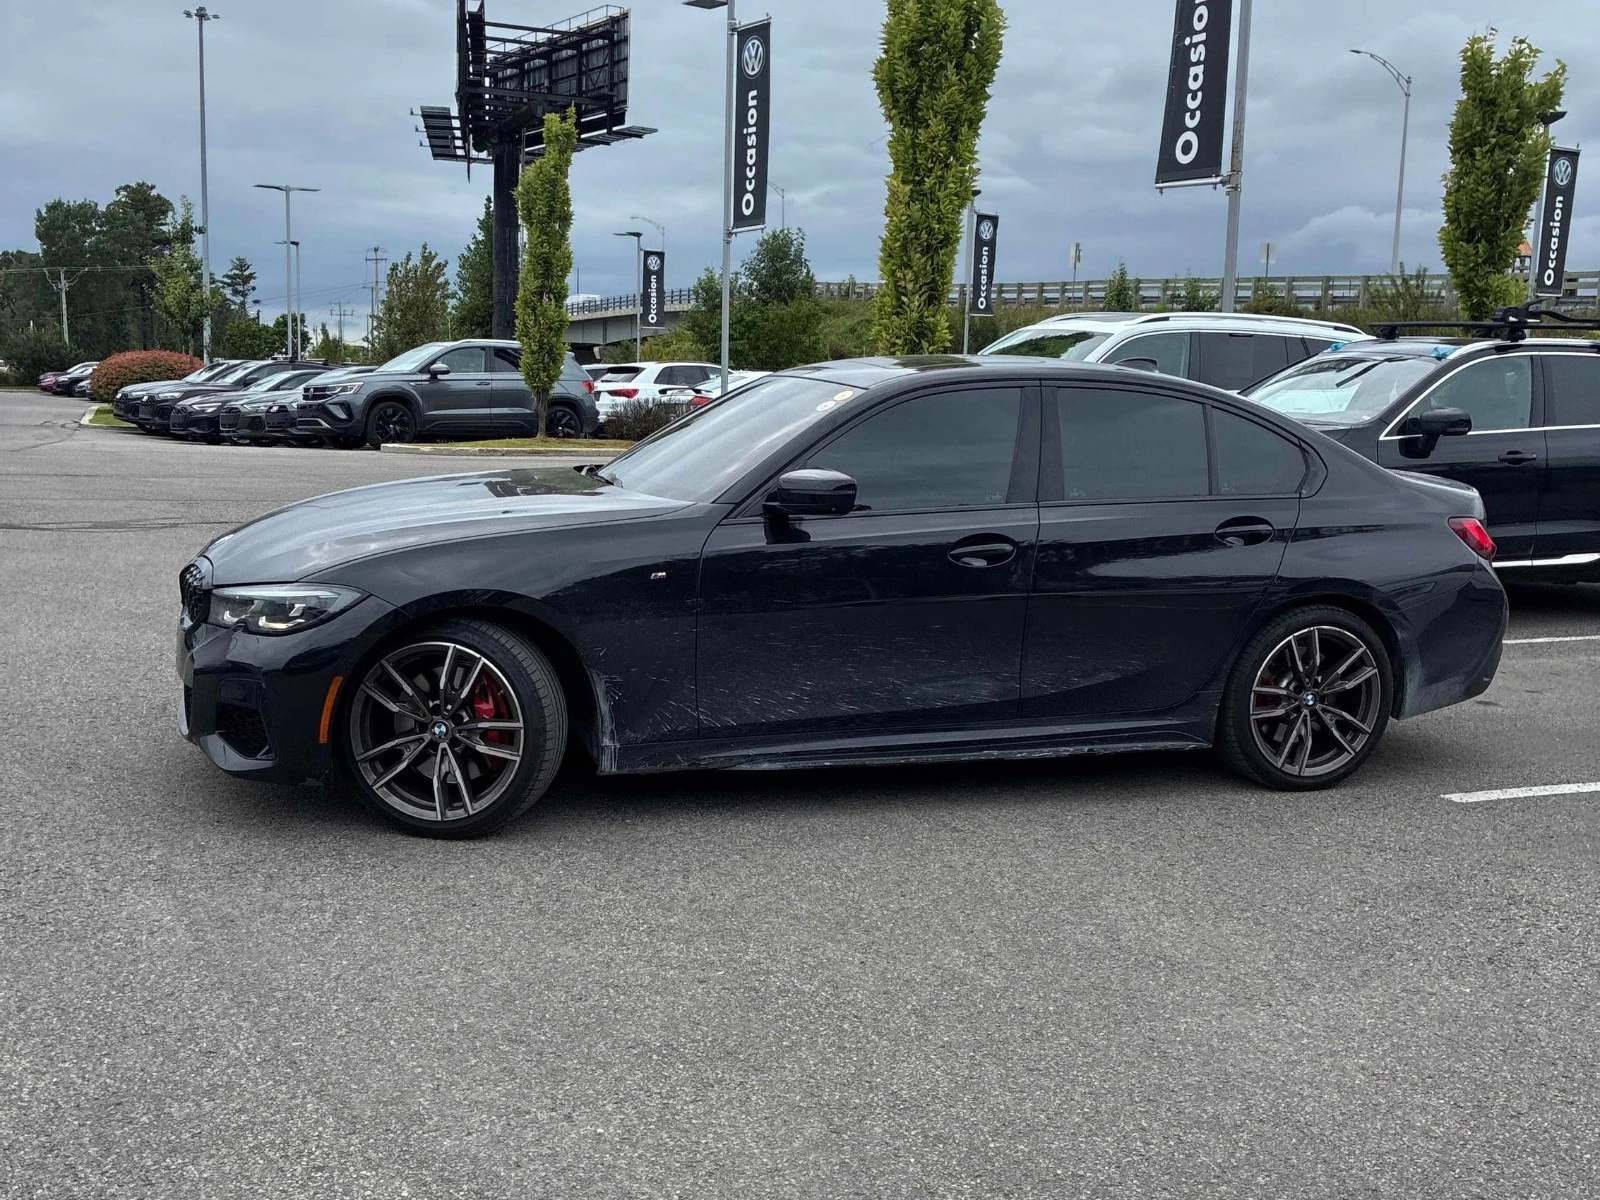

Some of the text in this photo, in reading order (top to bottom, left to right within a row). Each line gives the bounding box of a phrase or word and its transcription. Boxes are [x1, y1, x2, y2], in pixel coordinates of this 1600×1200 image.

[1175, 0, 1209, 165] Occasio
[741, 89, 758, 216] Occasion
[978, 246, 989, 310] Occasion
[1543, 195, 1564, 286] Occasion
[648, 274, 658, 324] Occasion
